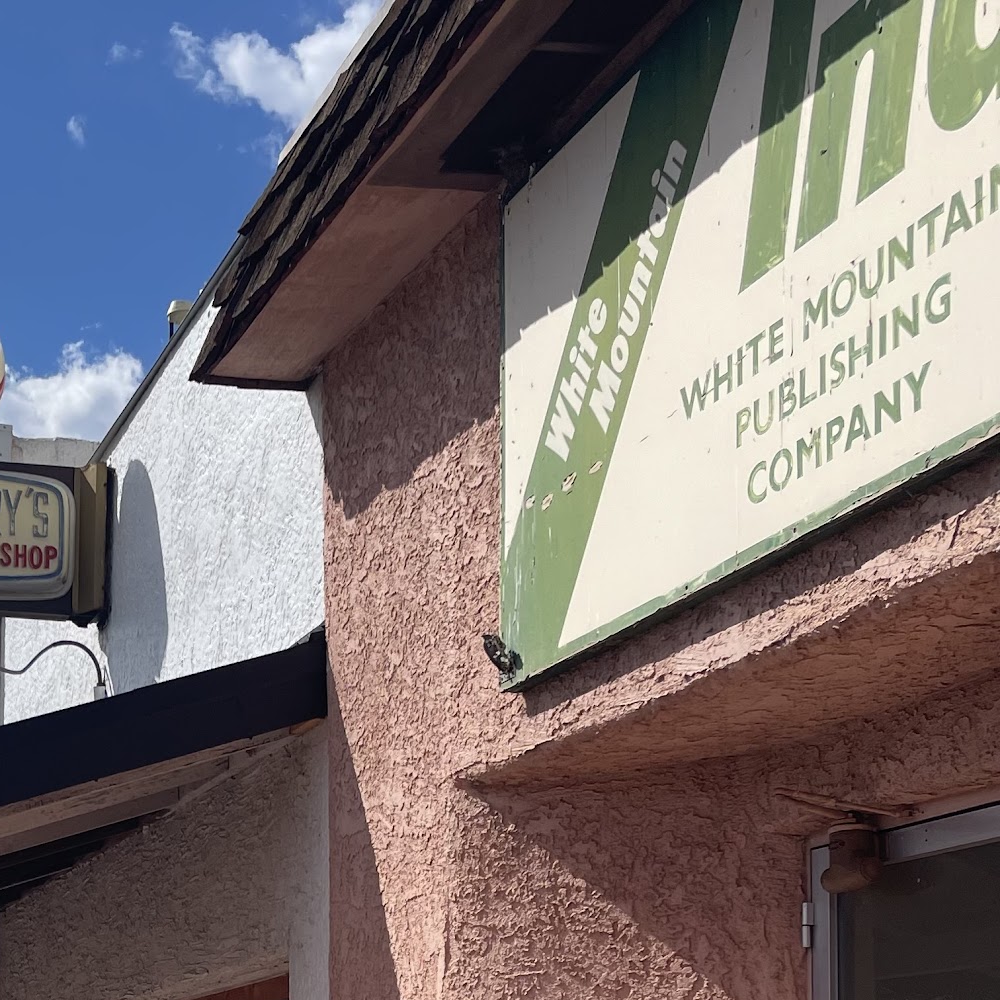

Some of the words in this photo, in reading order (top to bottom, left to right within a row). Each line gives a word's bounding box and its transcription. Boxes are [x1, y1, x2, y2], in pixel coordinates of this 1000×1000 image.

[589, 140, 687, 434] Mountain
[736, 272, 951, 449] PUBLISHING
[545, 298, 607, 462] White
[680, 317, 784, 420] WHITE
[748, 360, 932, 504] COMPANY
[0, 542, 58, 570] SHOP
